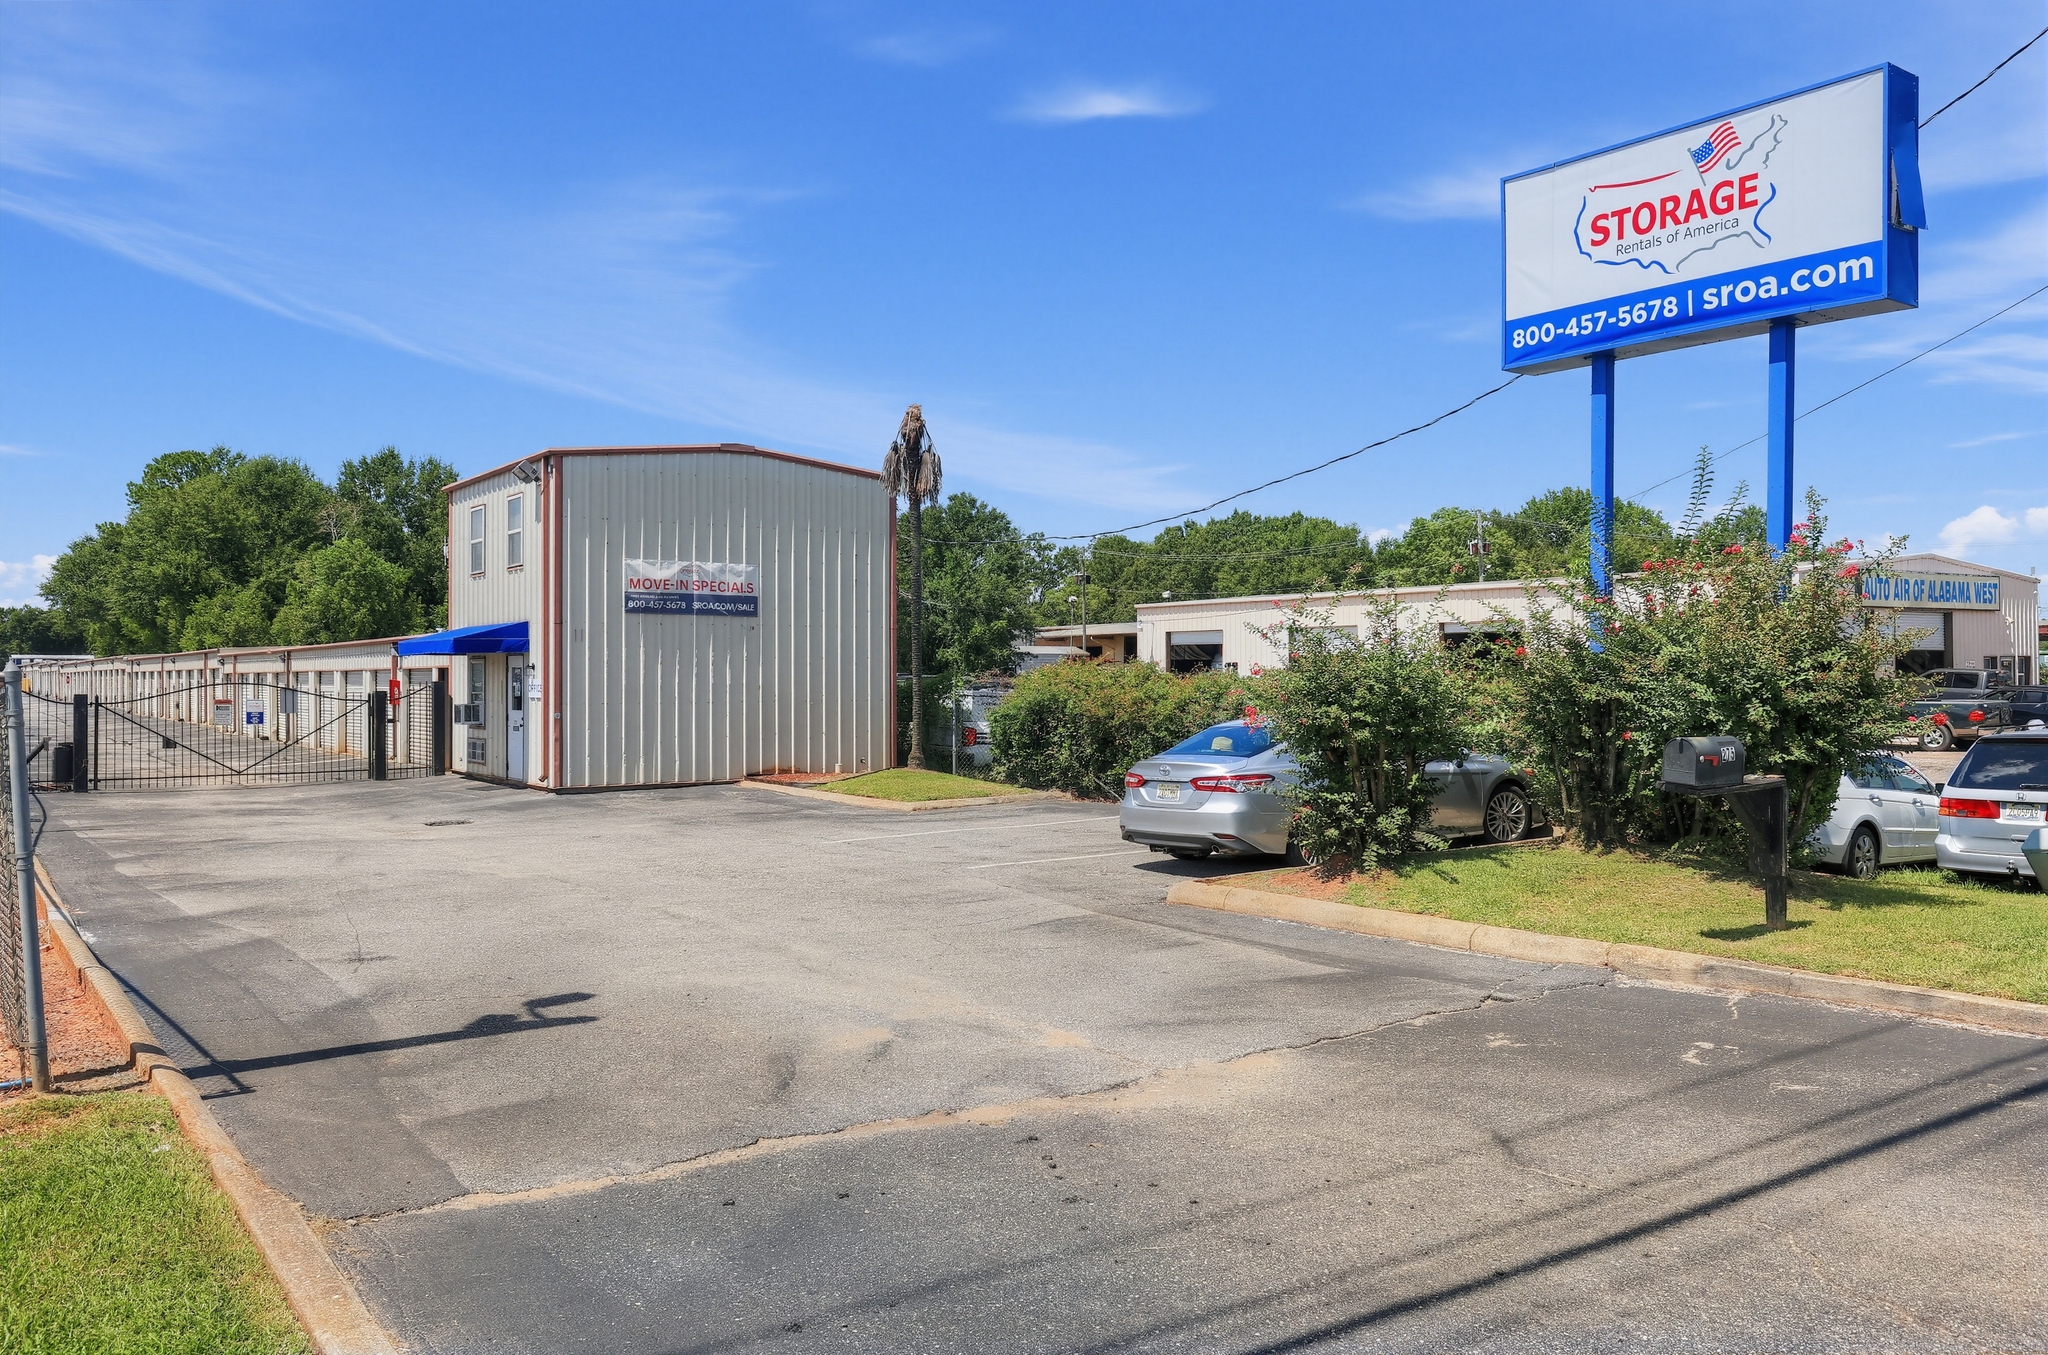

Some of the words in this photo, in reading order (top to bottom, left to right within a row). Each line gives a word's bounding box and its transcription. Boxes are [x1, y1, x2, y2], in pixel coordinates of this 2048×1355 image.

[1590, 172, 1759, 247] STORAGE
[1616, 235, 1662, 257] Rentals
[1666, 229, 1681, 245] of
[1684, 216, 1739, 241] America
[1512, 296, 1678, 349] 800-457-5678
[1703, 255, 1874, 310] sroa.com
[629, 578, 689, 591] MOVE-IN
[692, 580, 754, 594] SPECIALS
[1864, 577, 1890, 602] AUTO
[1893, 578, 1910, 602] AIR
[1913, 579, 1925, 603] OF
[1927, 579, 1971, 604] ALABAMA
[1973, 581, 1998, 605] WEST
[628, 600, 686, 609] 800-457-5678
[1721, 747, 1735, 762] 275
